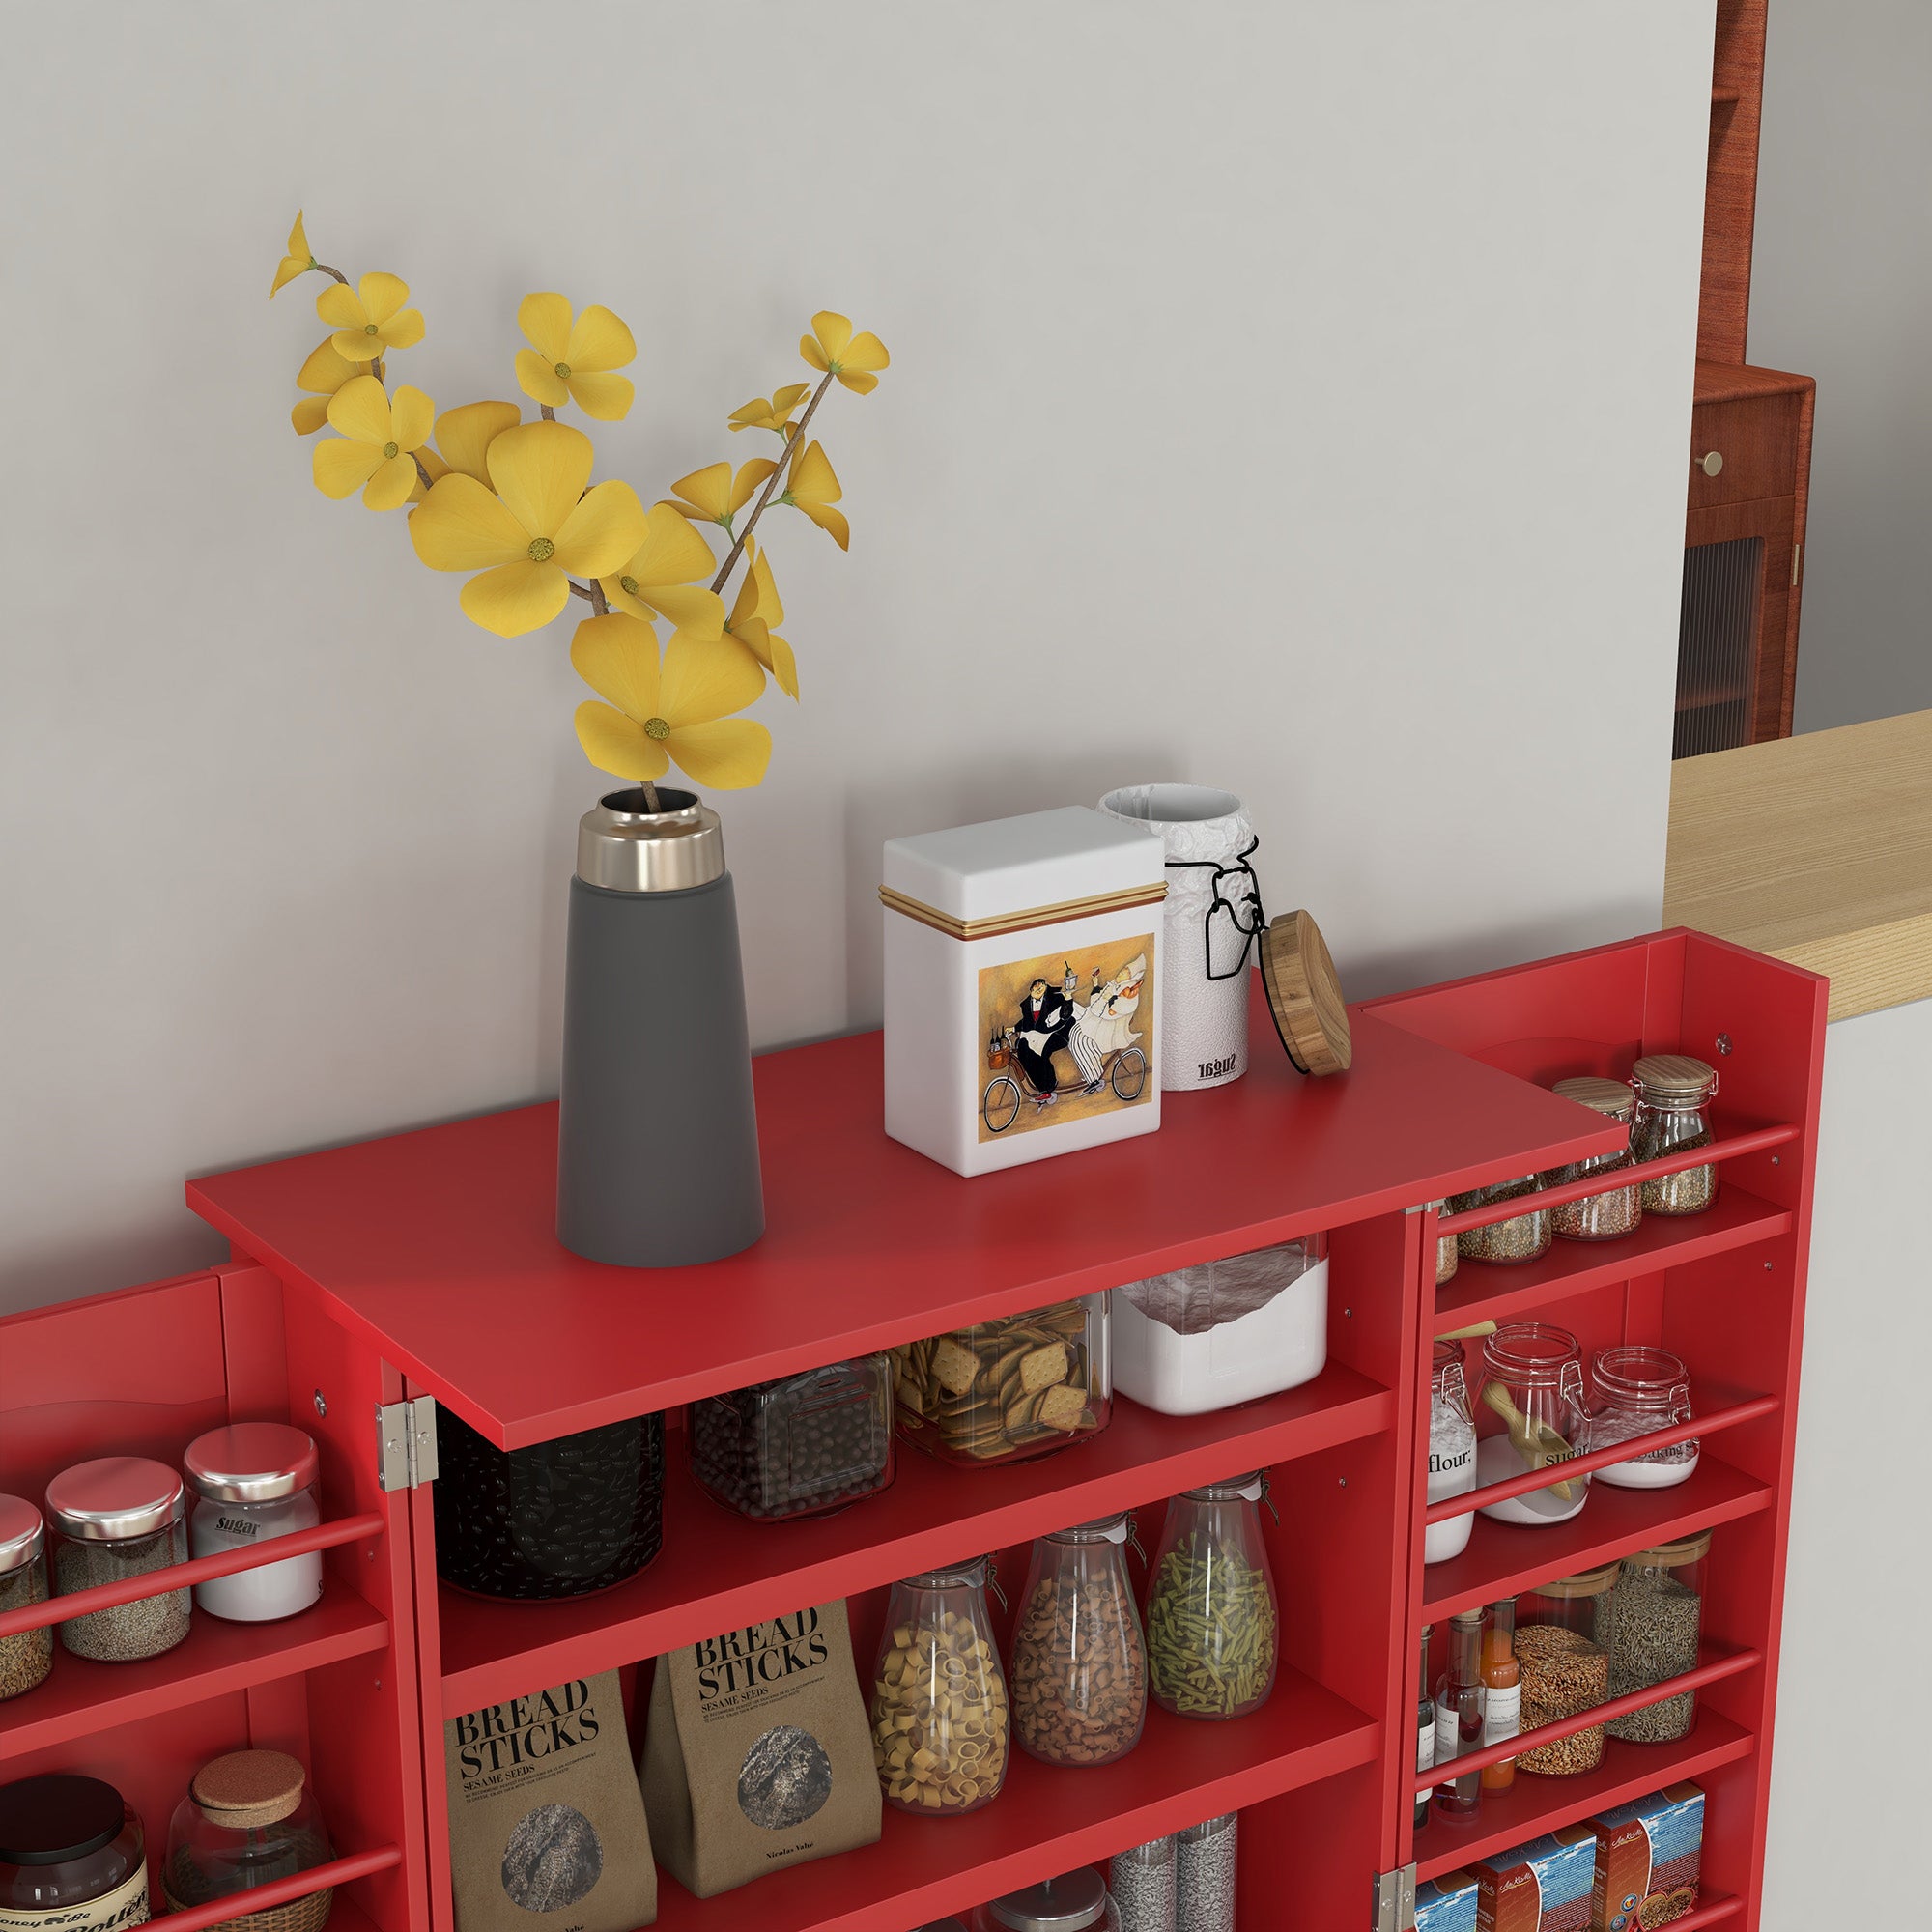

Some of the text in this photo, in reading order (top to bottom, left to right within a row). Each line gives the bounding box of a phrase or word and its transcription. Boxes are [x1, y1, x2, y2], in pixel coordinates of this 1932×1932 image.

[1637, 1443, 1683, 1459] aking
[214, 1517, 261, 1537] Sugar
[694, 1607, 818, 1669] BREAD
[698, 1634, 828, 1701] STICKS
[455, 1679, 588, 1747] BREAD
[701, 1686, 769, 1713] SESAME SEEDS
[460, 1707, 599, 1779] STICKS
[464, 1764, 535, 1792] SESAME SEEDS
[0, 1916, 42, 1928] oney
